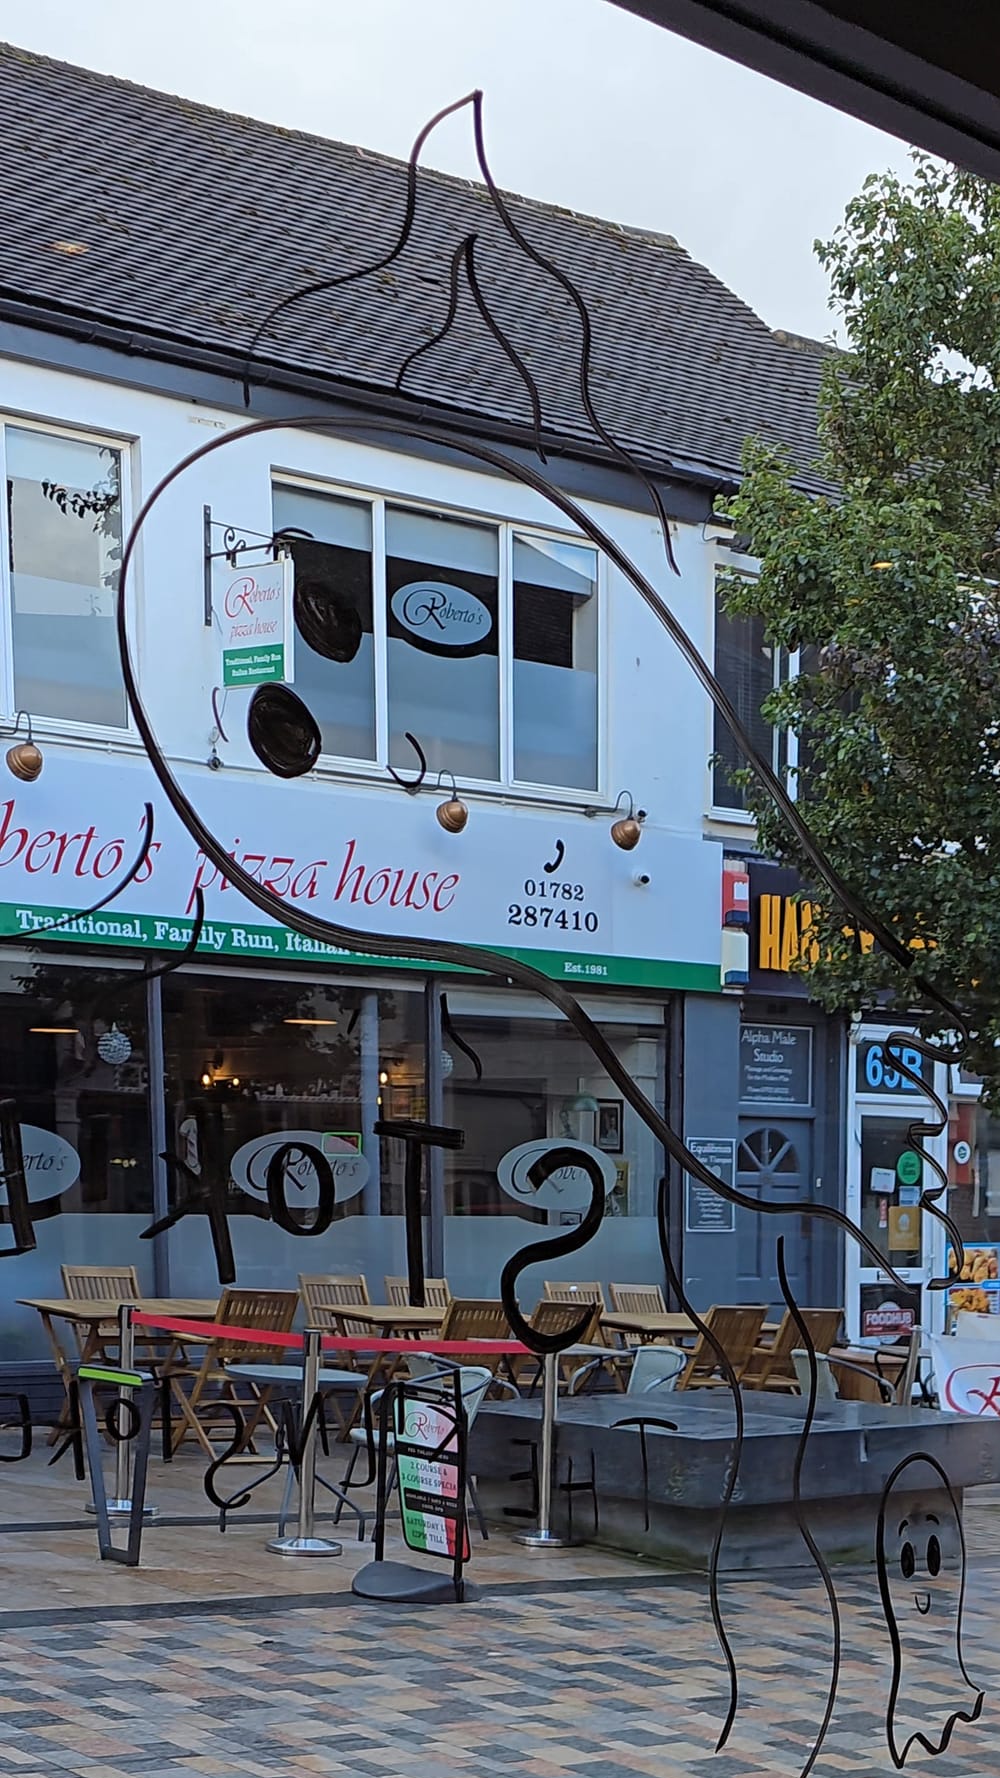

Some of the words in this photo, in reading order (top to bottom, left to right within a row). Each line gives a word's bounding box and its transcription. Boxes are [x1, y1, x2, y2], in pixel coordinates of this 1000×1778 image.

[403, 589, 483, 630] Roberto's
[334, 839, 460, 912] house
[524, 879, 584, 901] 01782
[507, 904, 599, 933] 287410
[16, 909, 147, 942] Traditional,
[231, 928, 279, 952] Run,
[563, 962, 607, 976] Est.1981
[741, 1029, 771, 1045] Alpha
[771, 1031, 798, 1045] Male
[753, 1048, 784, 1063] Studio
[866, 1312, 912, 1326] FOODHUB
[415, 1463, 442, 1476] COURSE
[406, 1473, 433, 1487] COURSE
[434, 1479, 457, 1491] SPECIA
